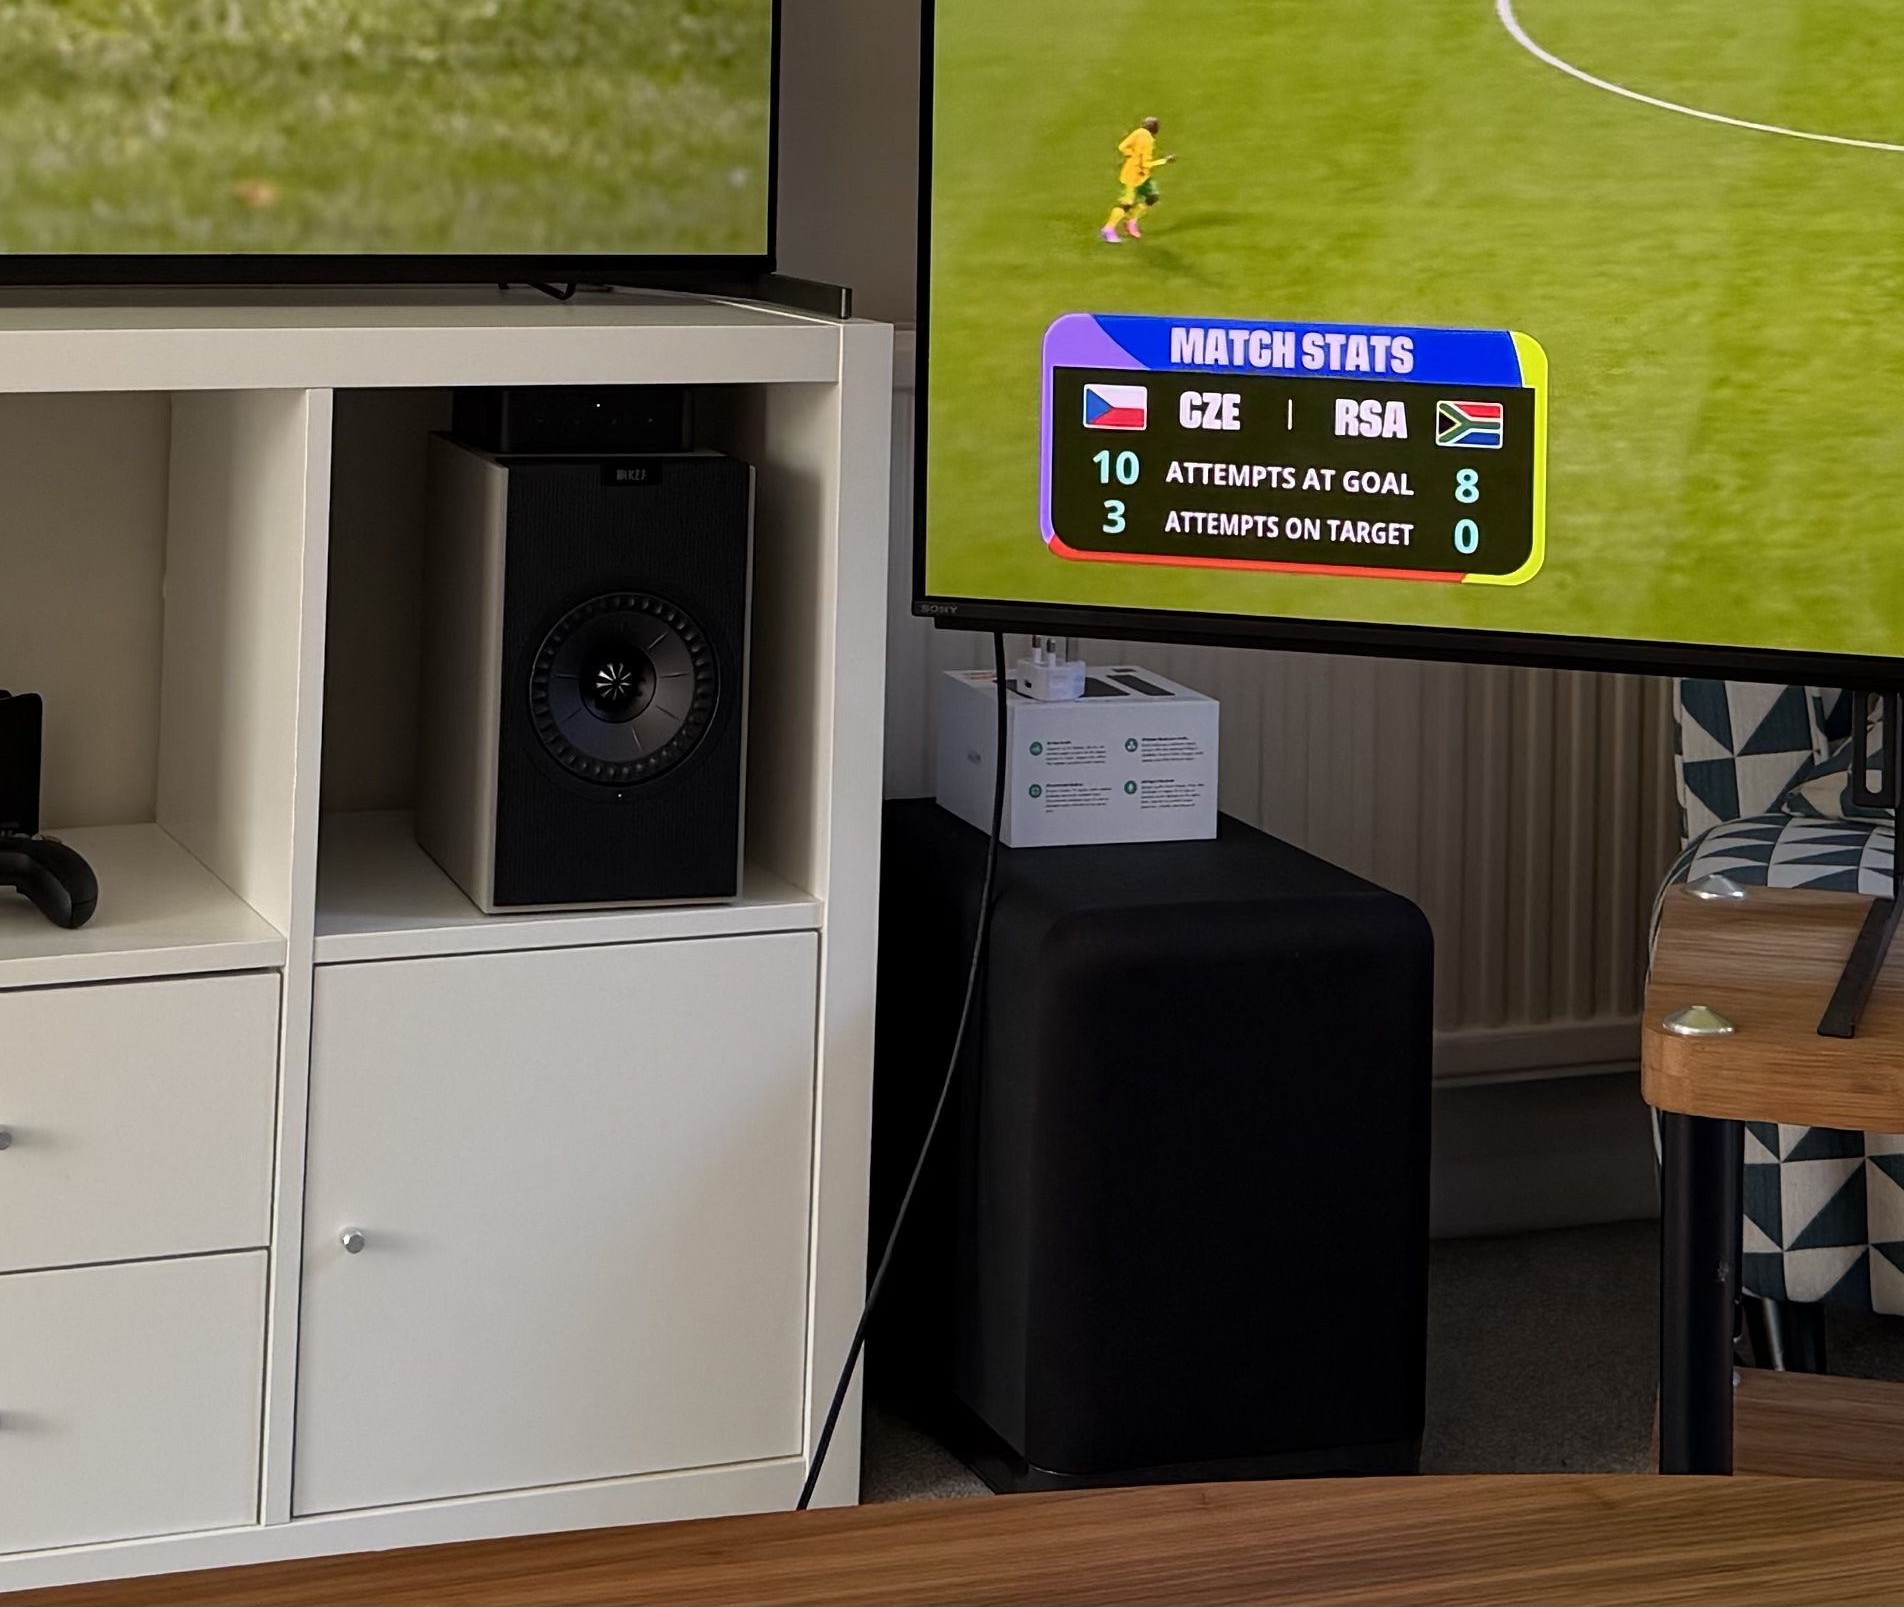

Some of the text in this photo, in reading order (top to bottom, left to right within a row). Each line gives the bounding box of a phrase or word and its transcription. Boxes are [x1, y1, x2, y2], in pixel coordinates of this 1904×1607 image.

[1170, 327, 1415, 374] MATCH STATS
[1179, 390, 1408, 440] CZE RSA
[1092, 450, 1480, 504] 10 ATTEMPTS AT GOAL 8
[1102, 499, 1479, 554] 3 ATTEMPTS ON TARGET 0
